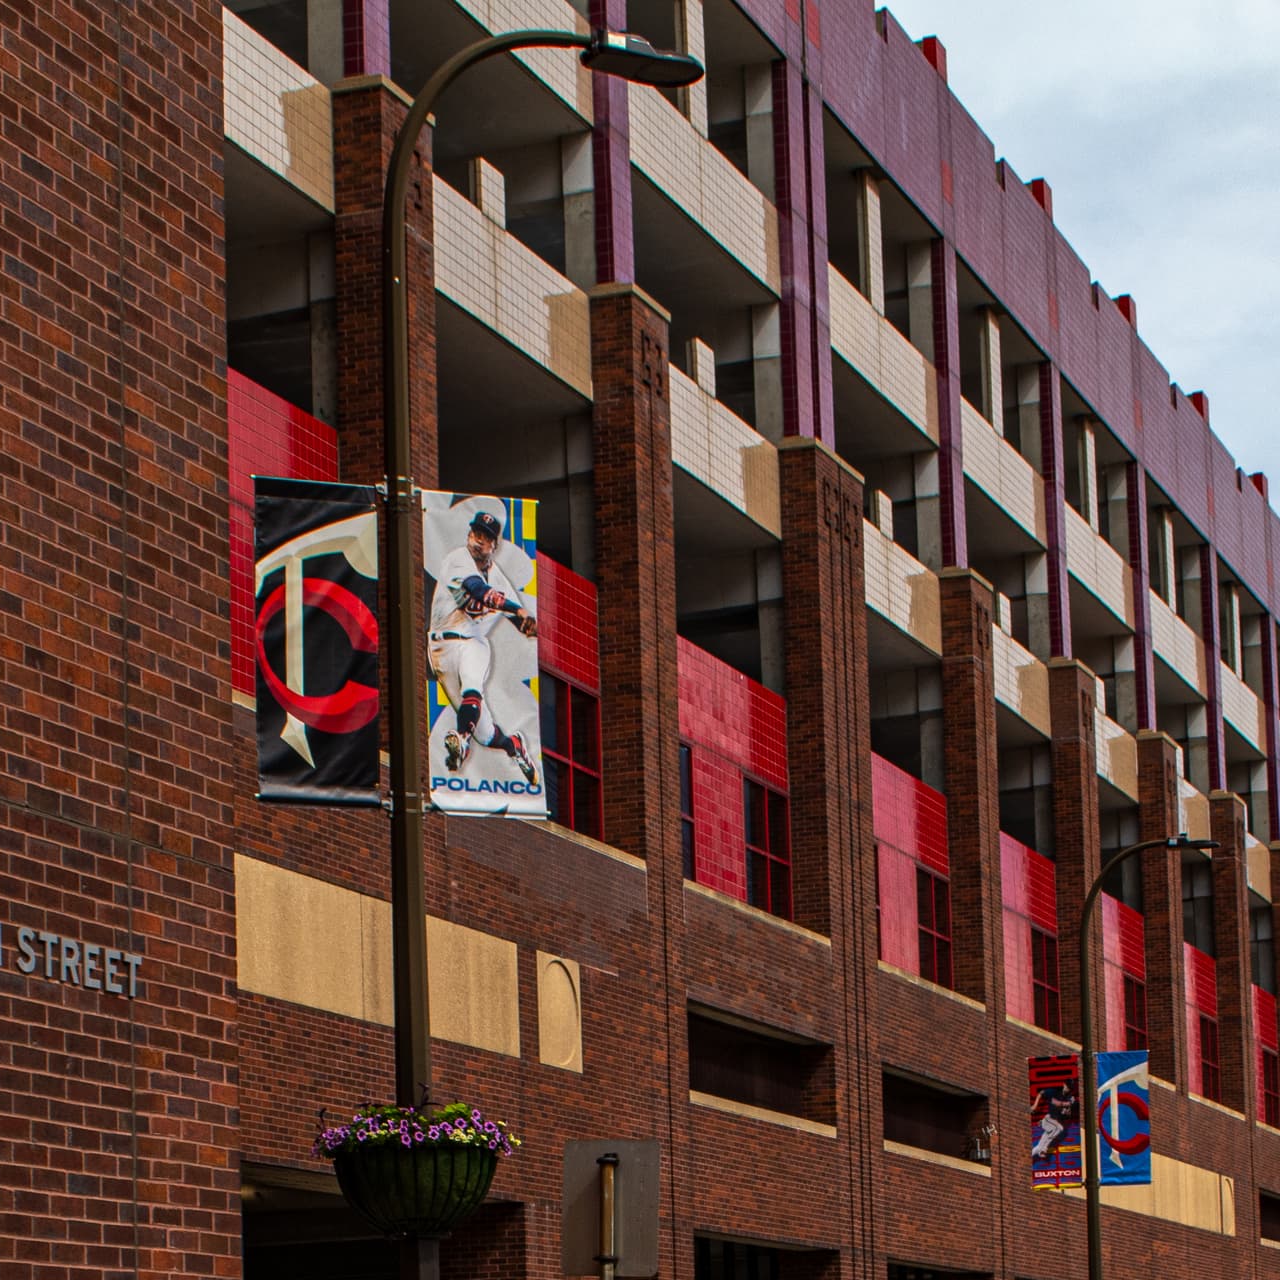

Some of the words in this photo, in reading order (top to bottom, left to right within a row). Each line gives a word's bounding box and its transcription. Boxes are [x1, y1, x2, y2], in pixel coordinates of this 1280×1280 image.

[431, 775, 543, 797] POLANCO
[16, 926, 143, 999] STREET
[1034, 1169, 1080, 1178] BUXTON
